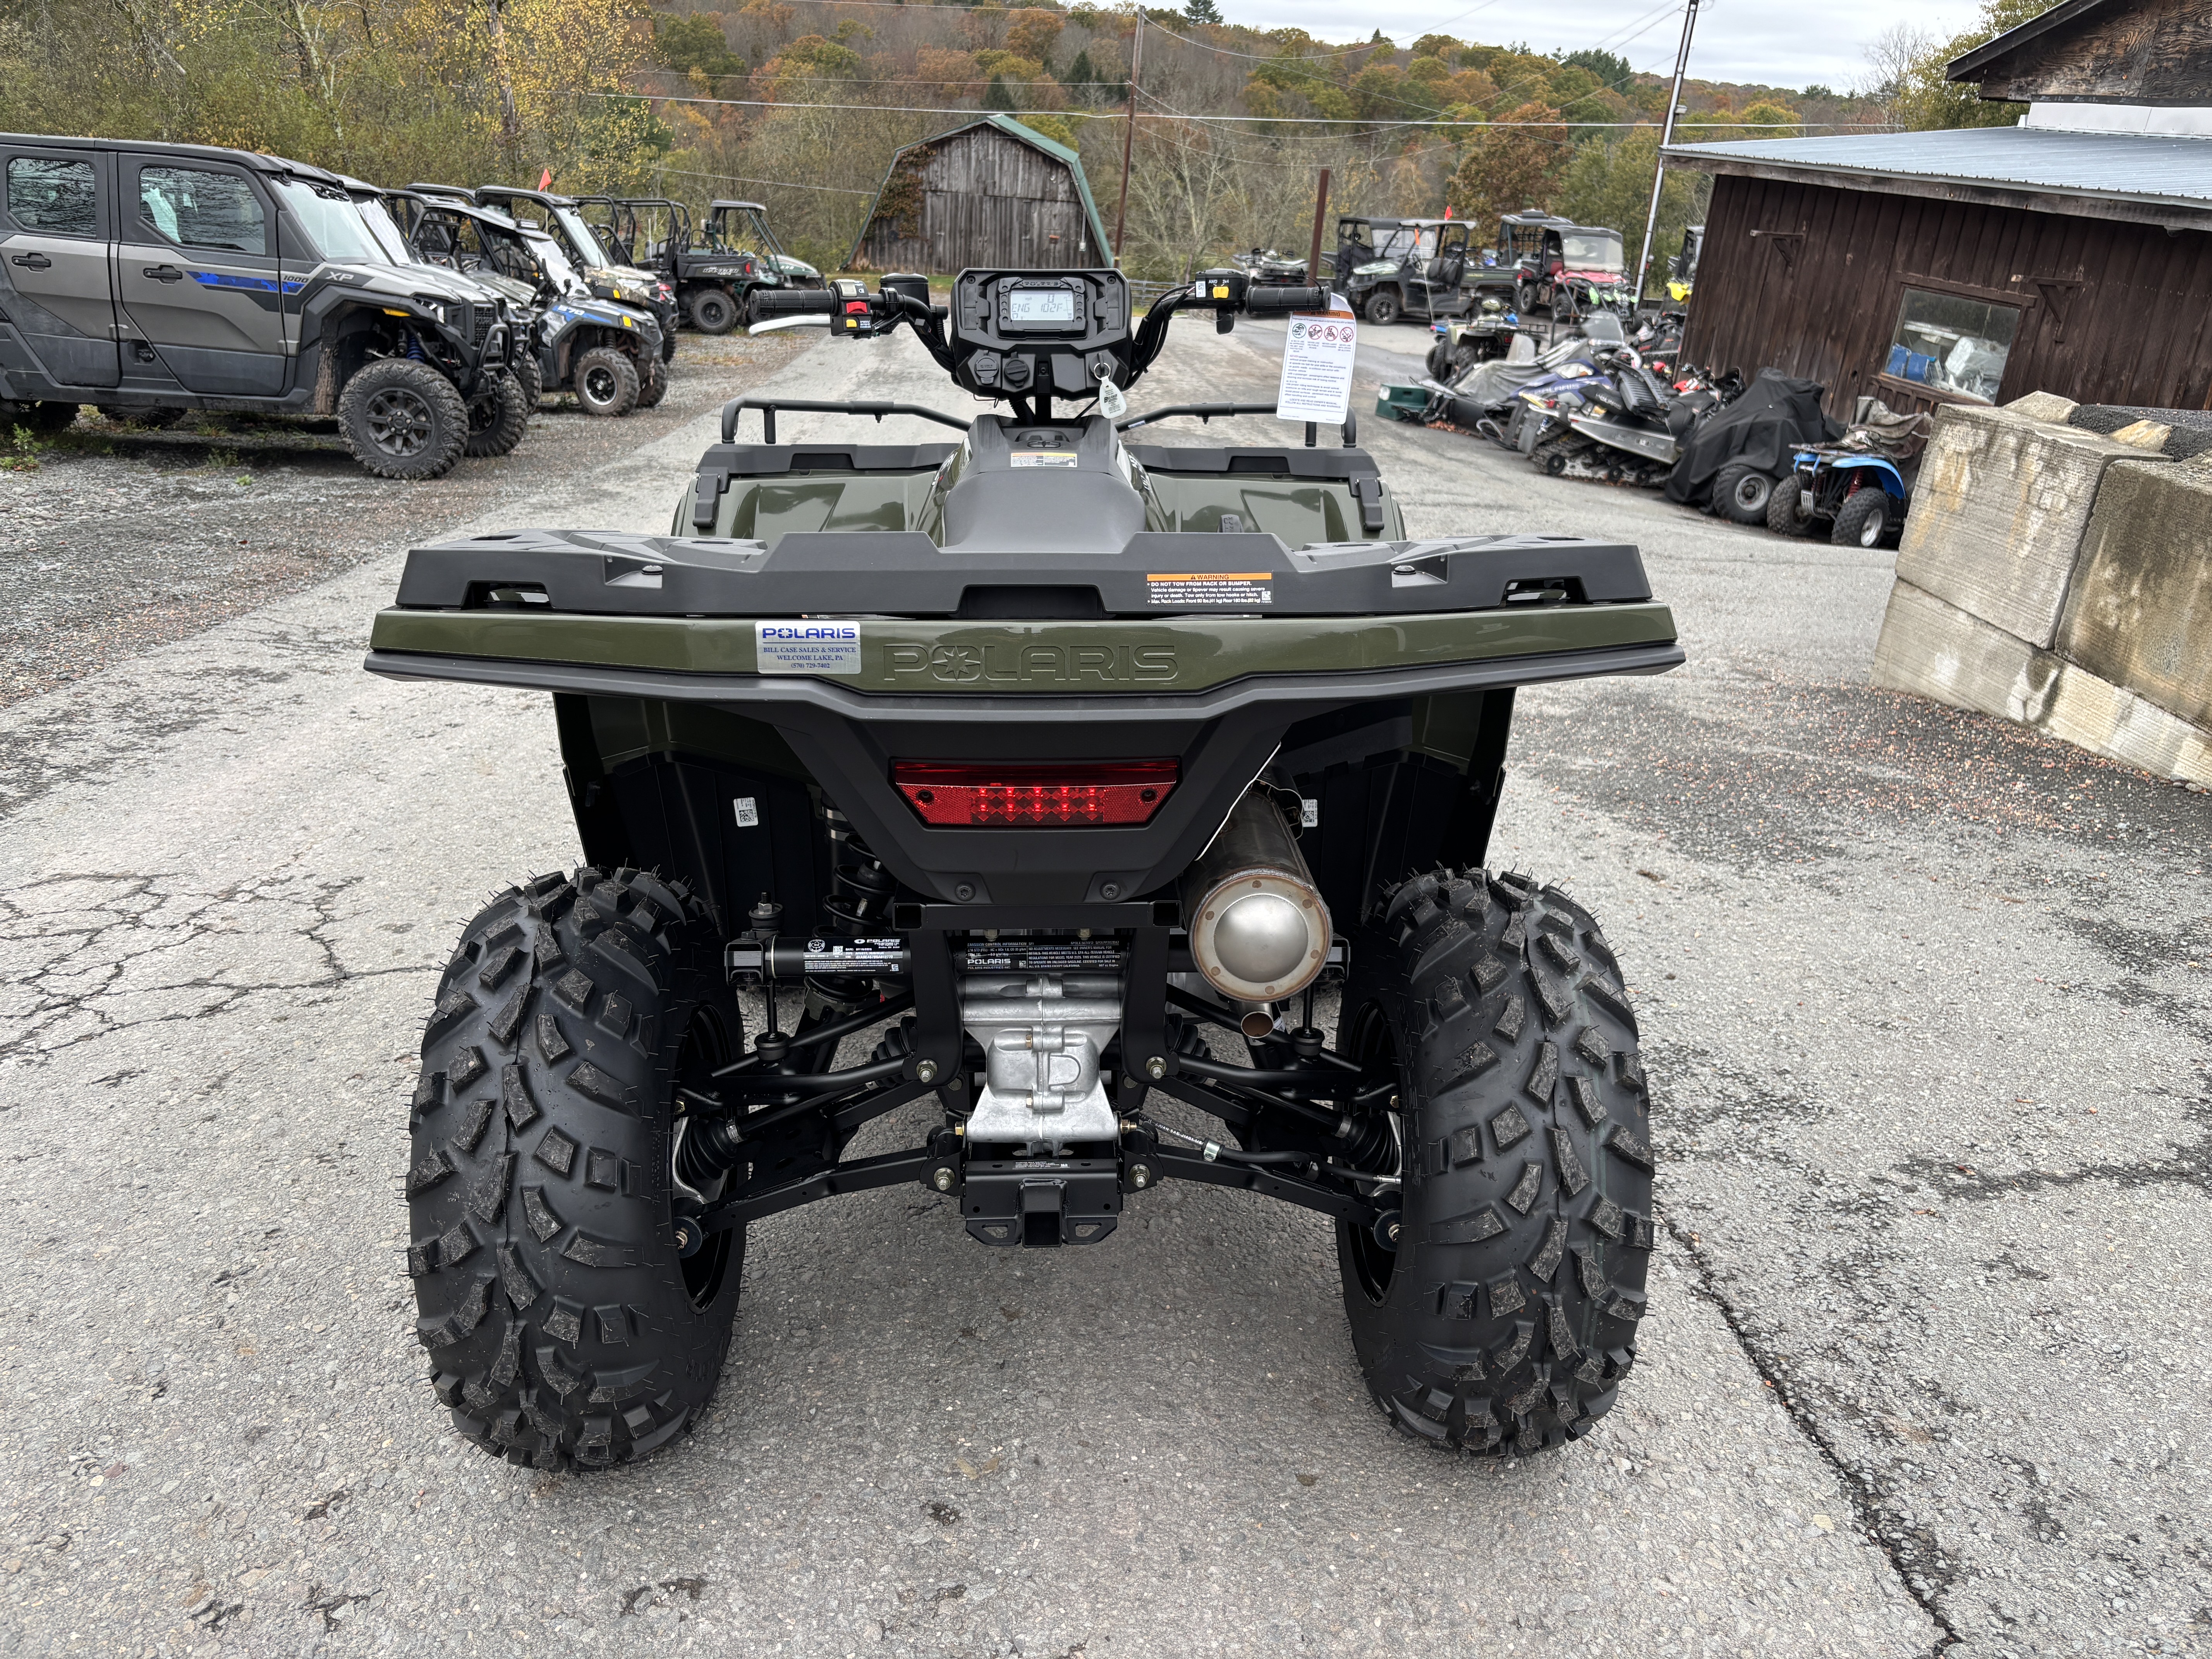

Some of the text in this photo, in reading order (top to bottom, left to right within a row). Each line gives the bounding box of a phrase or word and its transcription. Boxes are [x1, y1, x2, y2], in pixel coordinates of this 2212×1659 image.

[325, 271, 354, 281] XP
[1047, 294, 1055, 303] 0
[1012, 304, 1063, 312] ENG 102F
[763, 628, 855, 638] POLARIS
[883, 646, 1178, 680] POLARIS
